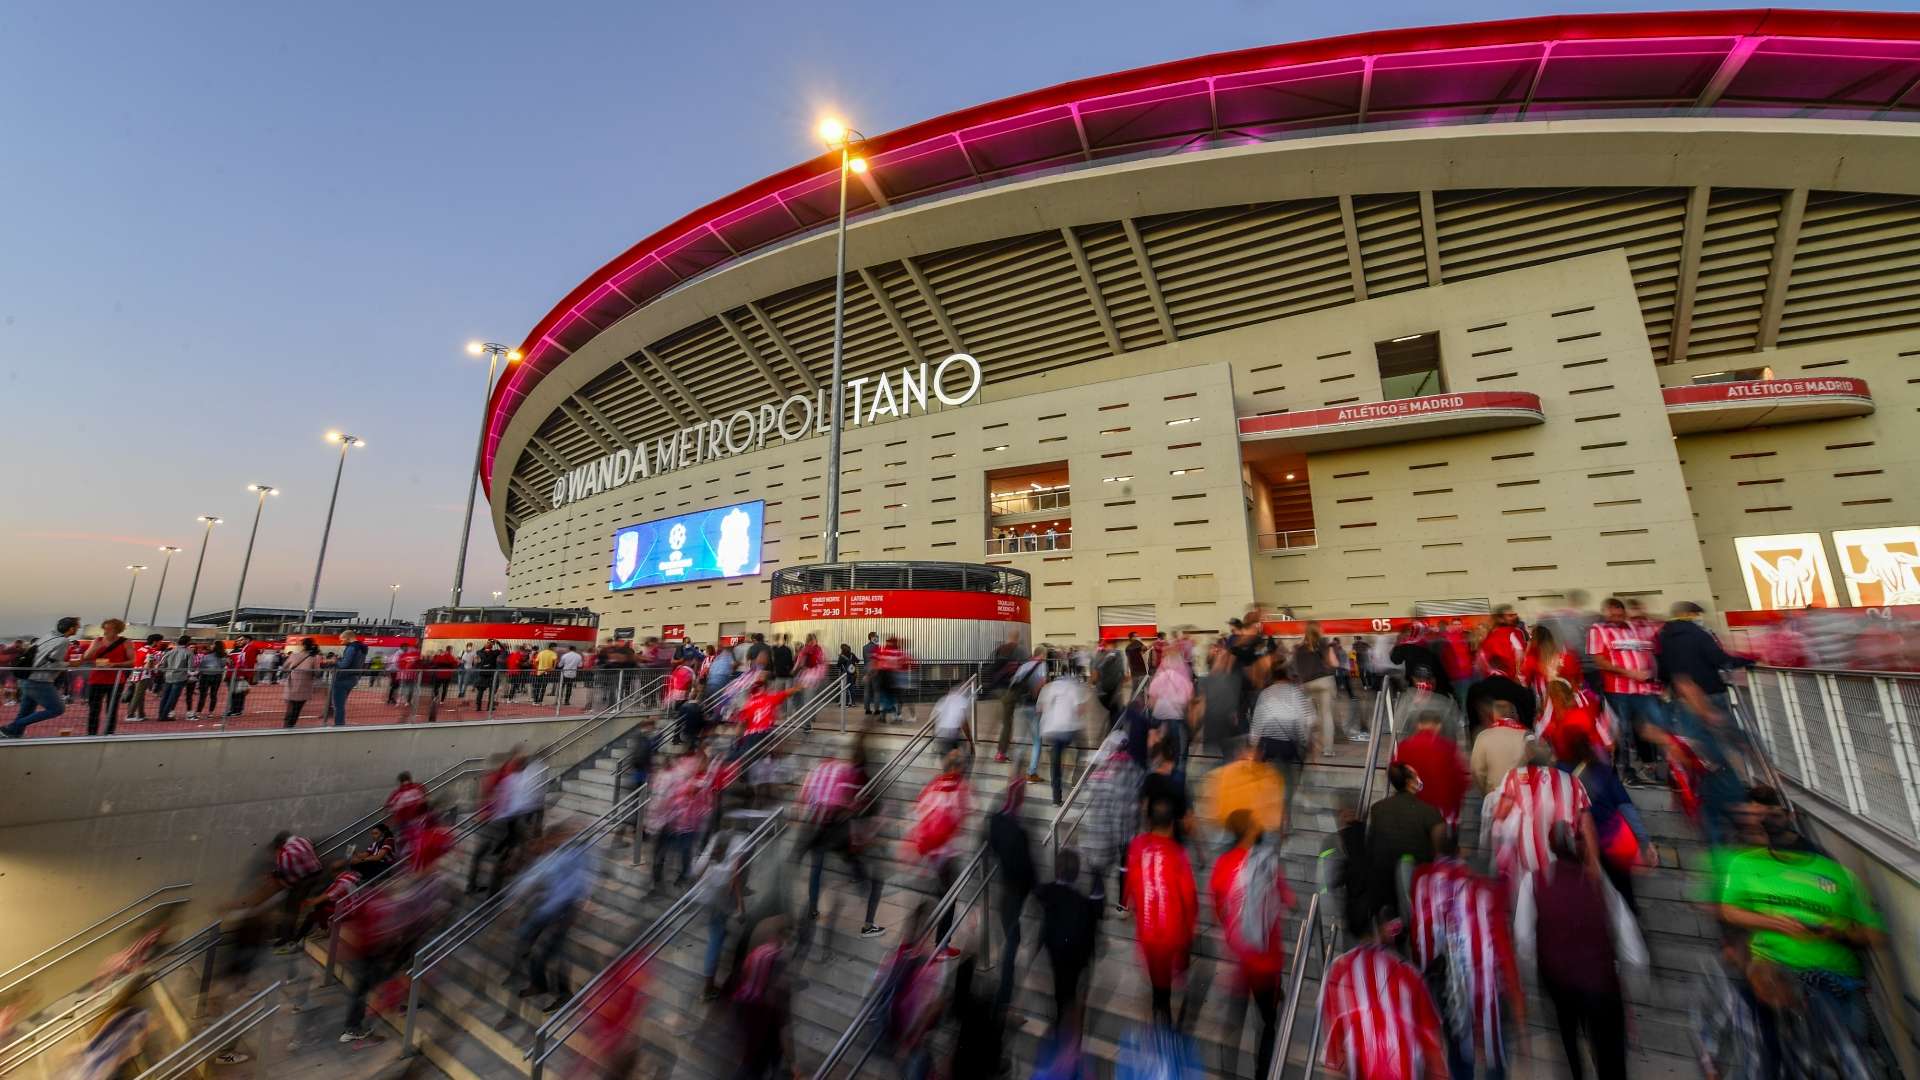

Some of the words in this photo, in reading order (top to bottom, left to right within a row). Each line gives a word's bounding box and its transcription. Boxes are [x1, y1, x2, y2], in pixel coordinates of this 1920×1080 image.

[1727, 382, 1793, 397] ATLÉTICO
[1806, 381, 1853, 392] MADRID
[1338, 404, 1398, 420] ATLÉTICO
[1409, 396, 1464, 411] MADRID
[568, 441, 649, 502] WANDA
[1372, 618, 1392, 632] 05
